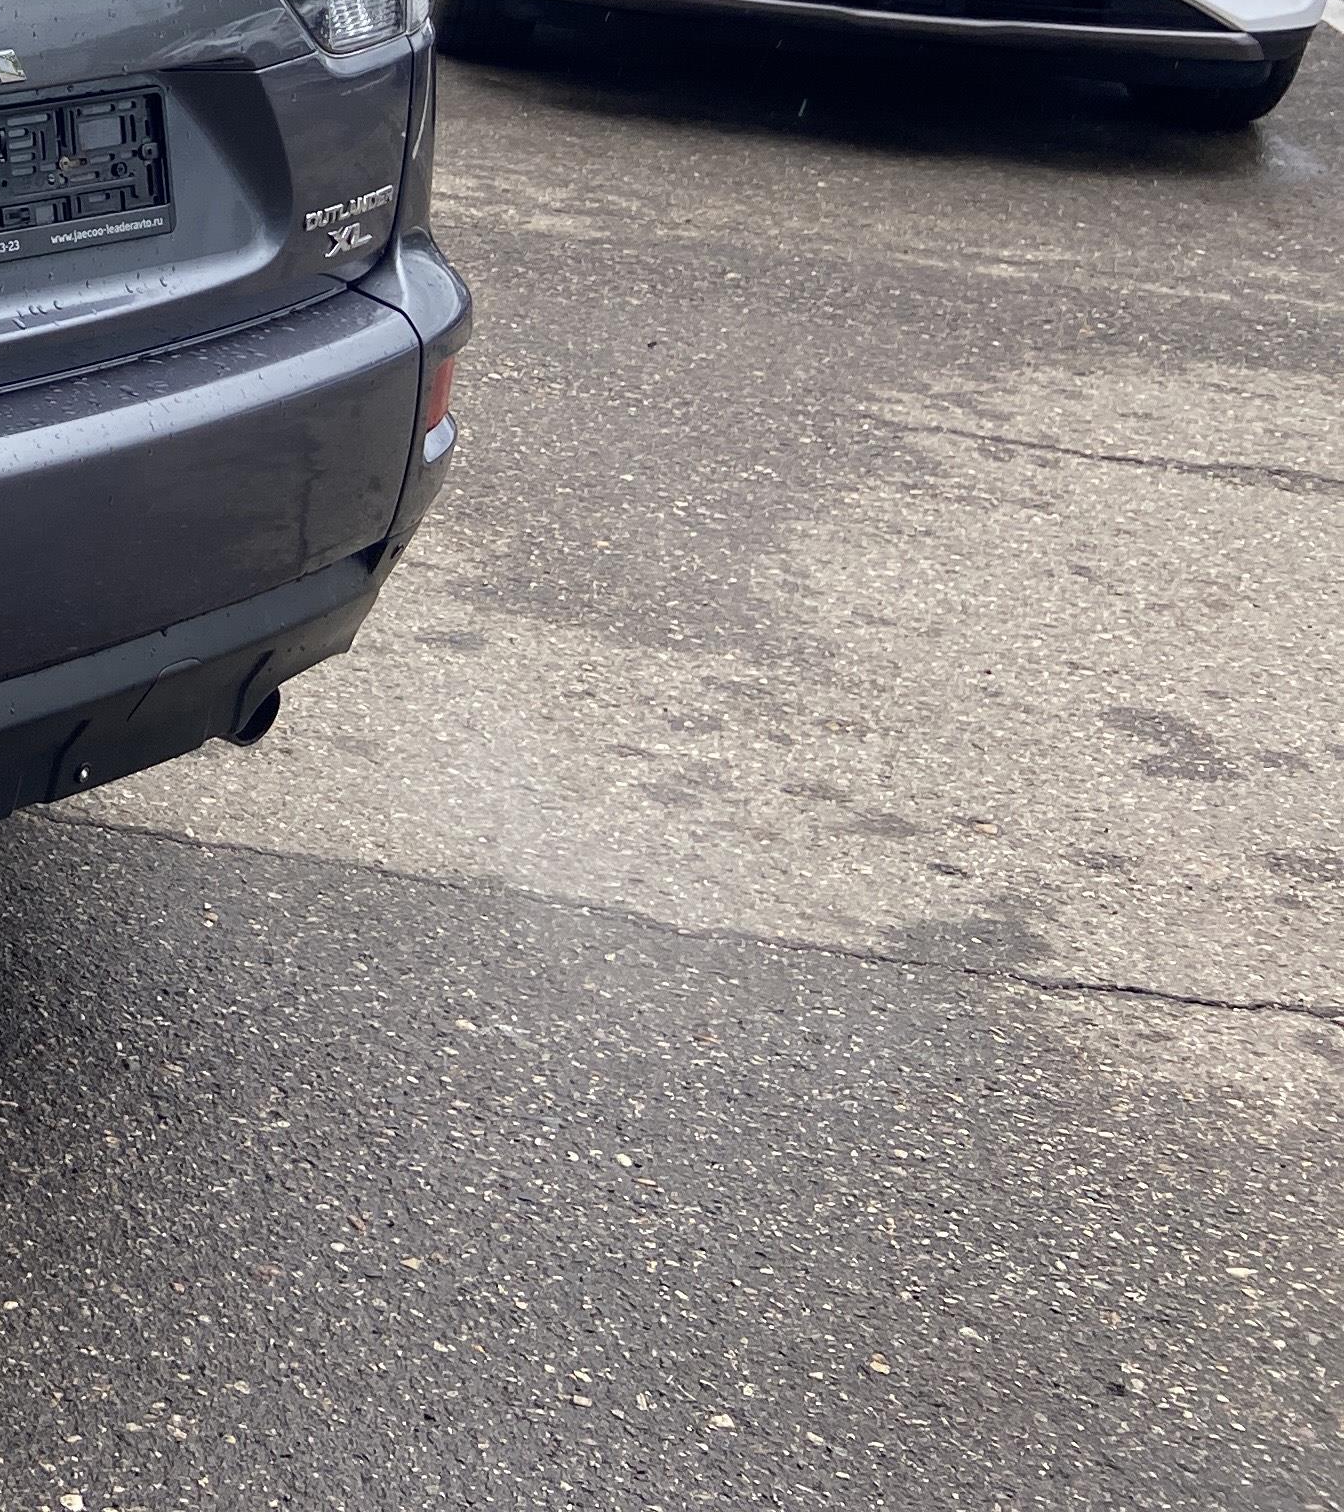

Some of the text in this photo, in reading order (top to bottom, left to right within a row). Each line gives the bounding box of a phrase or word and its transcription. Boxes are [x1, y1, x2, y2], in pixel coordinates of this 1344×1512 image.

[305, 184, 394, 231] OUTLANDER
[50, 217, 164, 244] www.jaecoo-leaderavto.ru
[324, 222, 373, 258] XL
